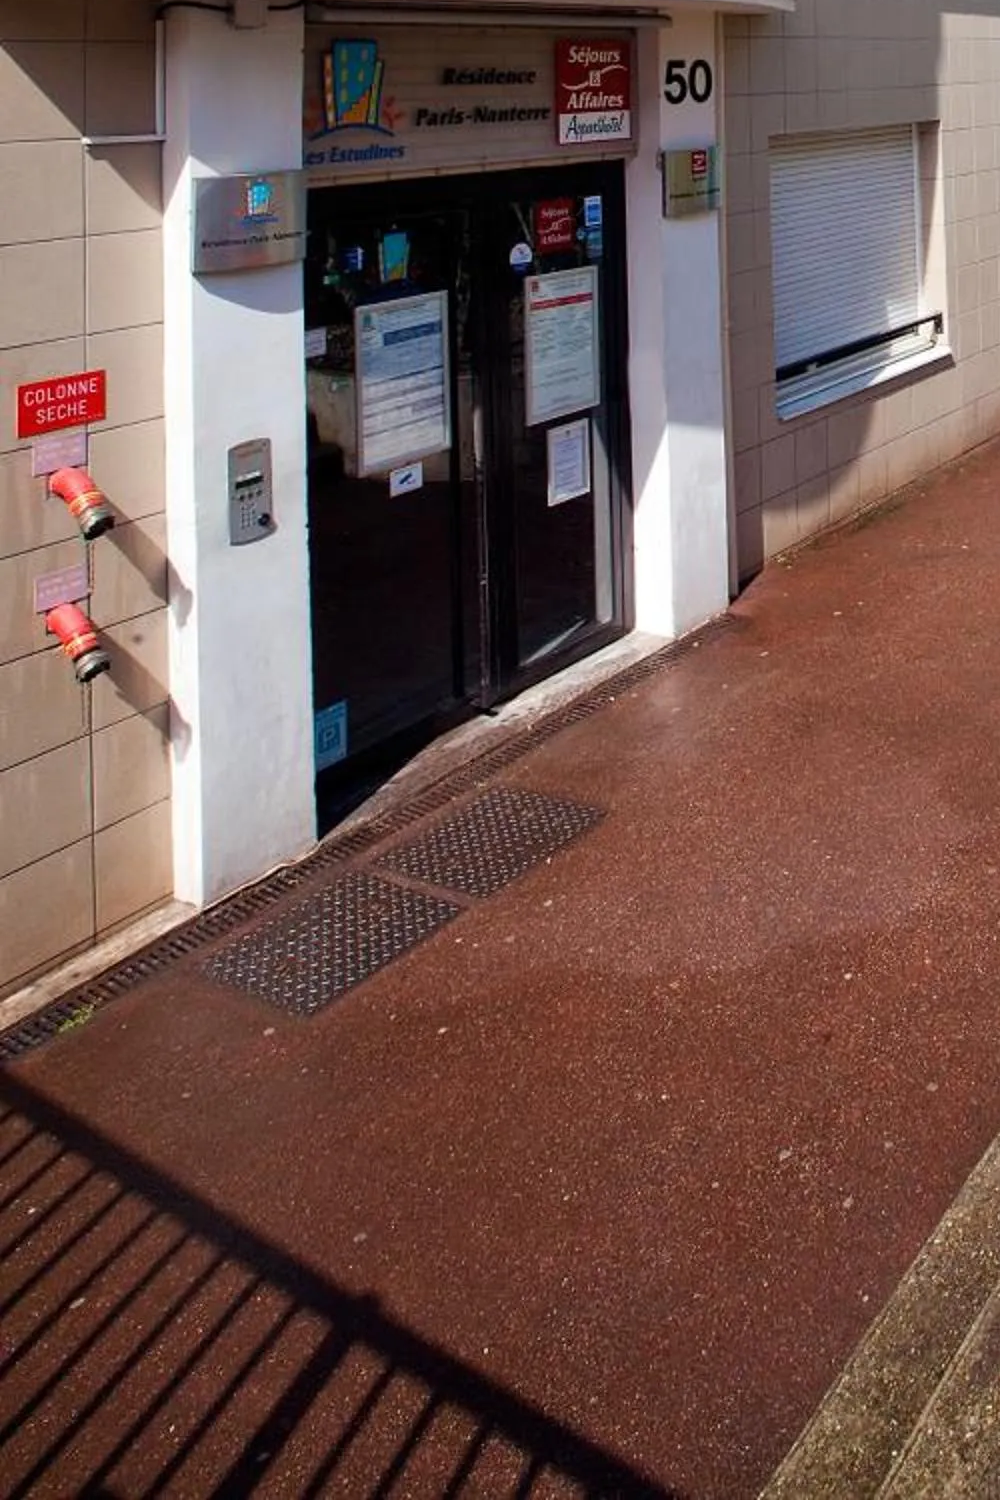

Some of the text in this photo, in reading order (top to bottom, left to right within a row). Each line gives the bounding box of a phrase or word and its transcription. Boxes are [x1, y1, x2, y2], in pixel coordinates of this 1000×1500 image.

[568, 45, 621, 68] Séjours
[442, 66, 537, 86] Résidence
[663, 59, 712, 104] 50
[567, 91, 624, 109] Affaires
[415, 104, 551, 127] Paris-Nanterre
[305, 151, 325, 165] es
[23, 377, 98, 407] COLONNE
[35, 399, 87, 425] SECHE
